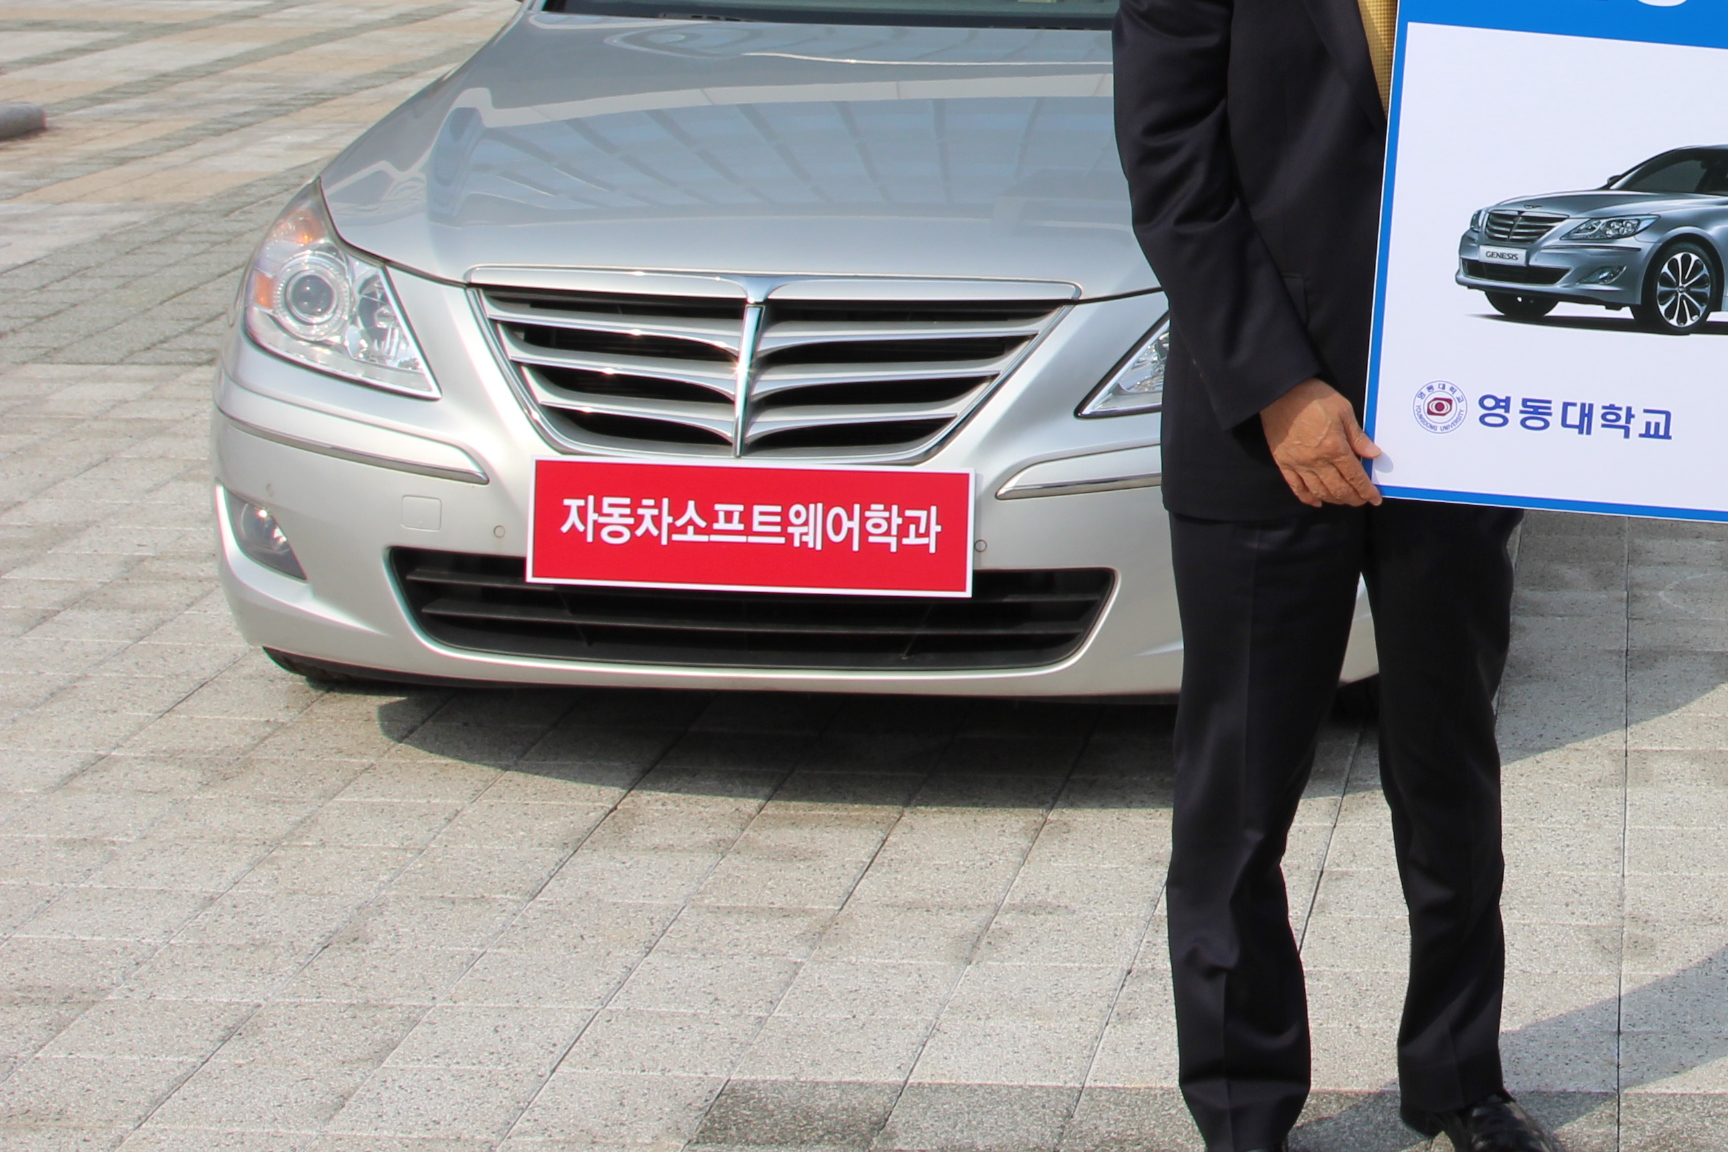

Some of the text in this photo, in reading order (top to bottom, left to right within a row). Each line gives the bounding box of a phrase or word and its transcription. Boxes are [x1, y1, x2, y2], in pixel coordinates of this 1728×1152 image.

[1485, 251, 1519, 261] GENESIS
[1477, 394, 1673, 441] 영동대학교
[560, 494, 942, 554] 자동차소프트웨어학과
